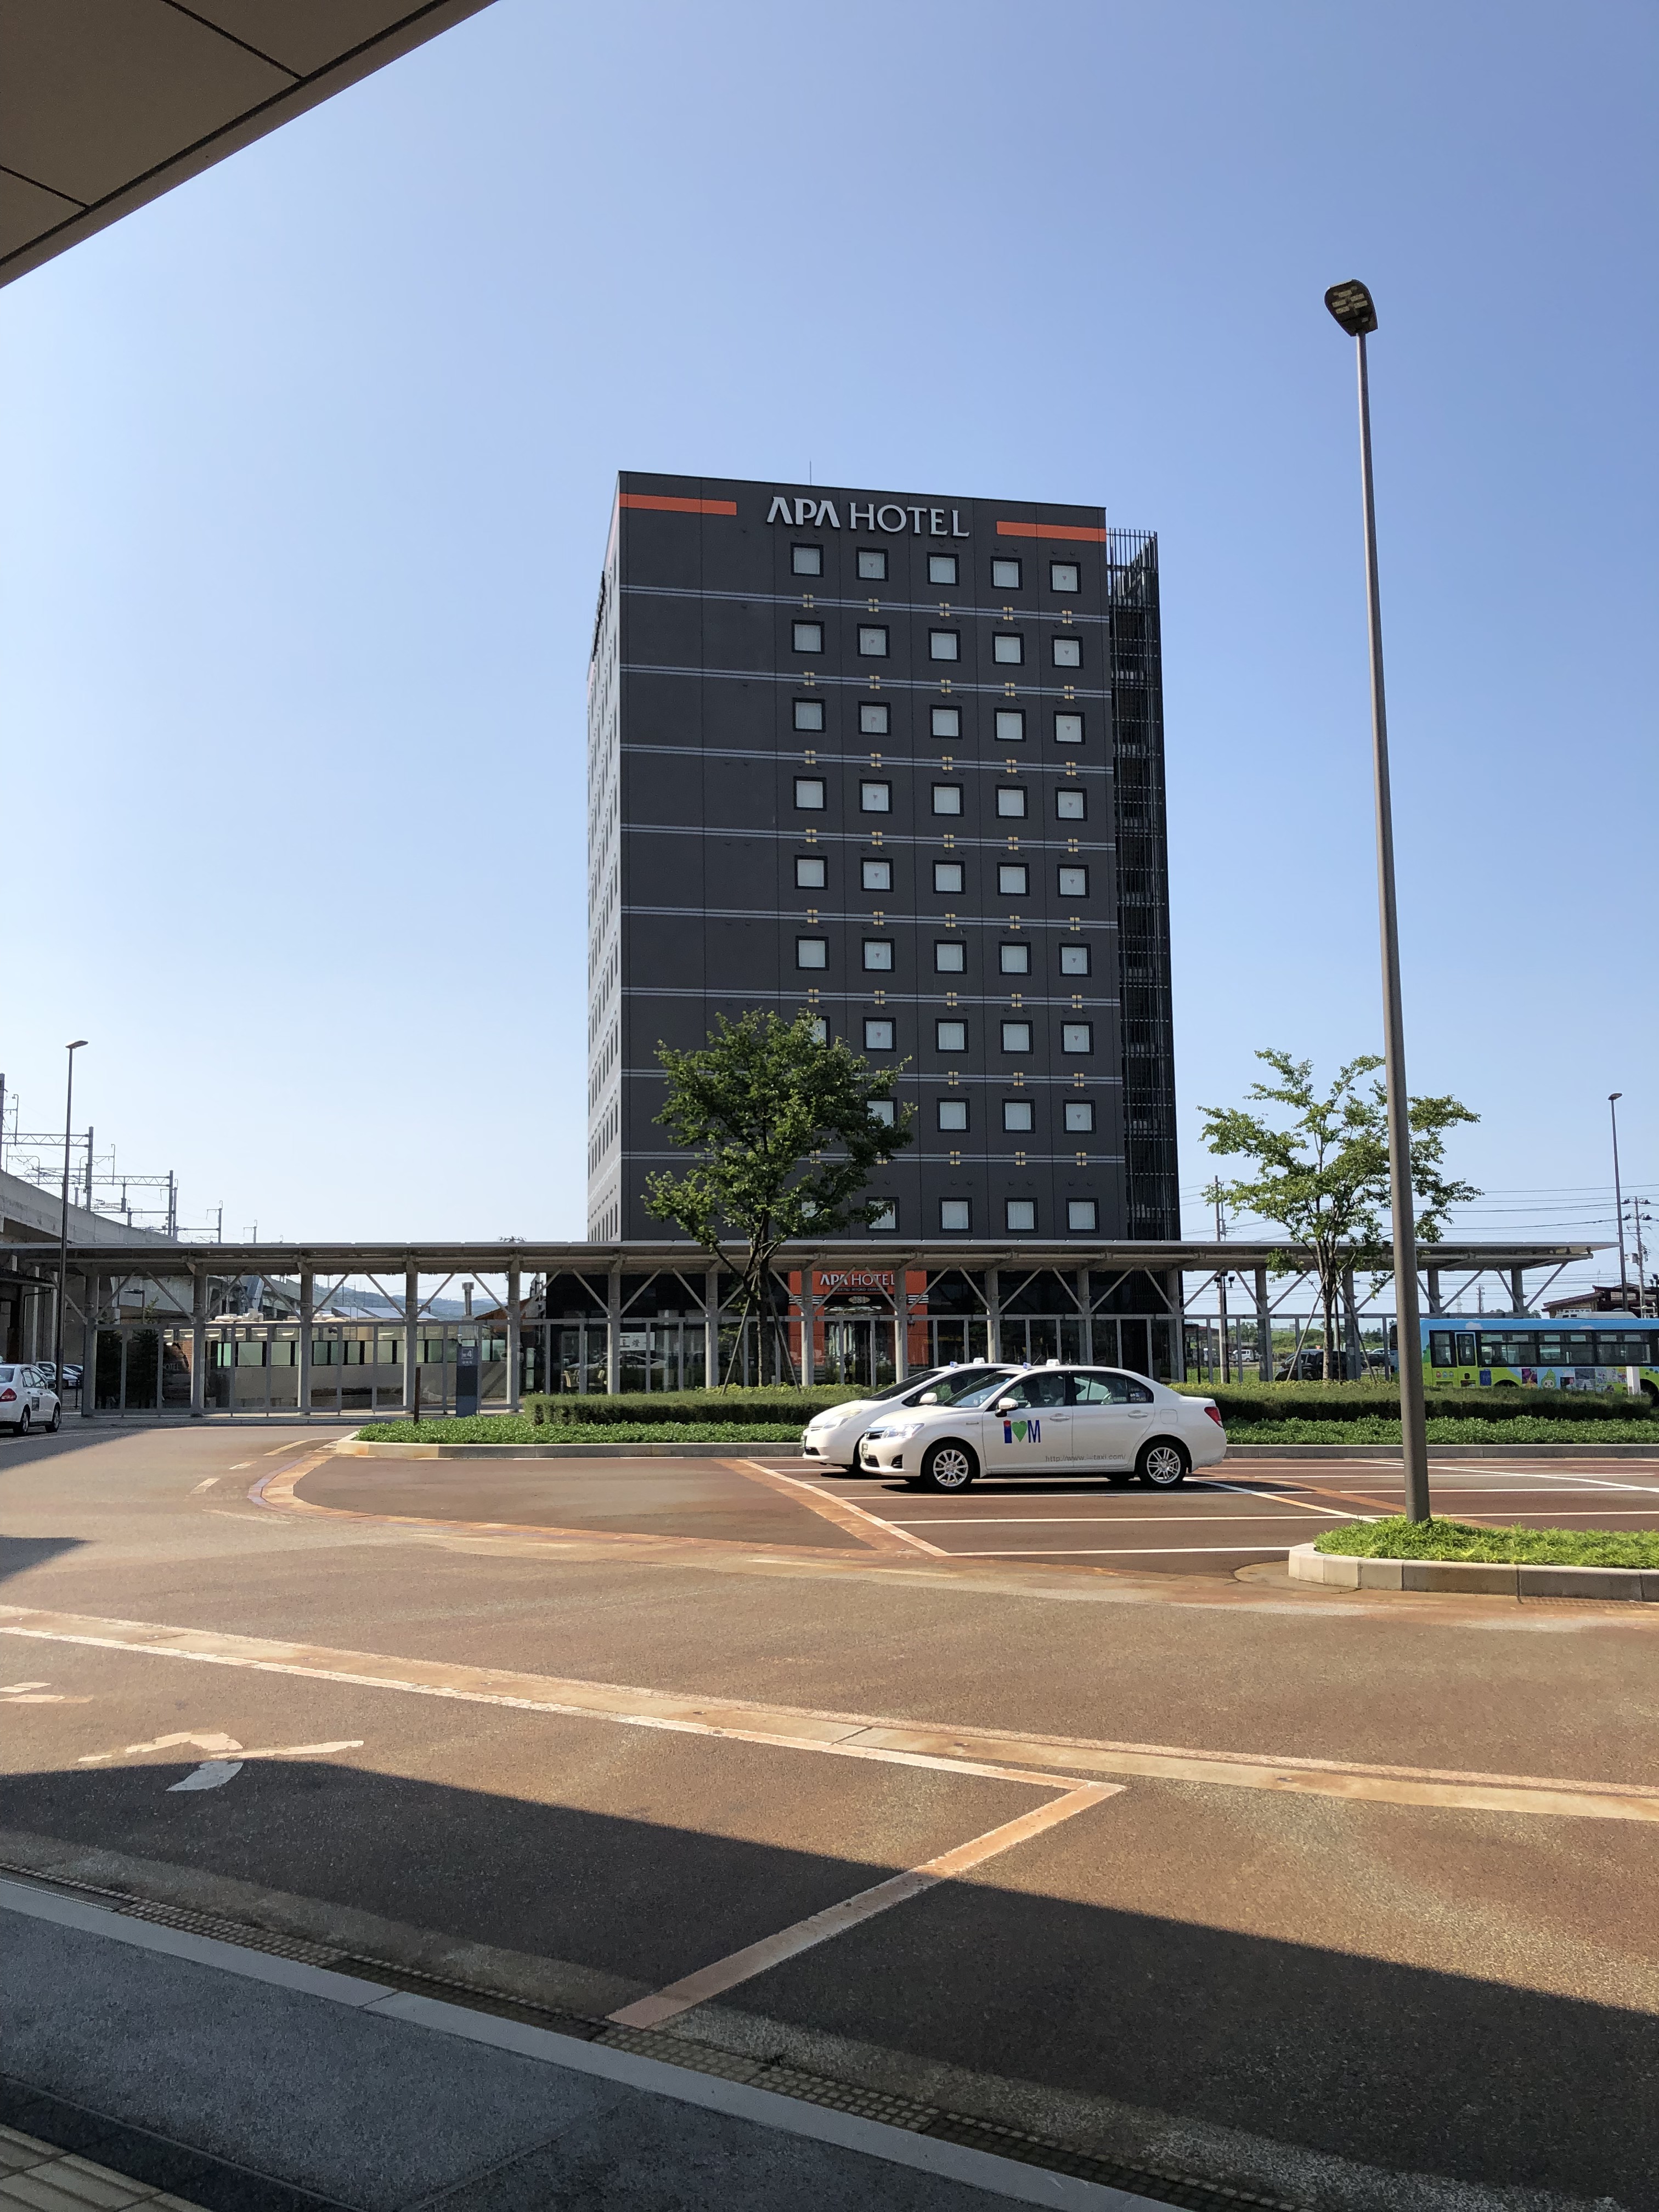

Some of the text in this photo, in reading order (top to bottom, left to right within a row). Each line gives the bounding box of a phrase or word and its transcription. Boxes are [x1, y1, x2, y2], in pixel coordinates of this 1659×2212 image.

[767, 496, 970, 537] APA HOTEL
[820, 1274, 895, 1285] APA HOTEL
